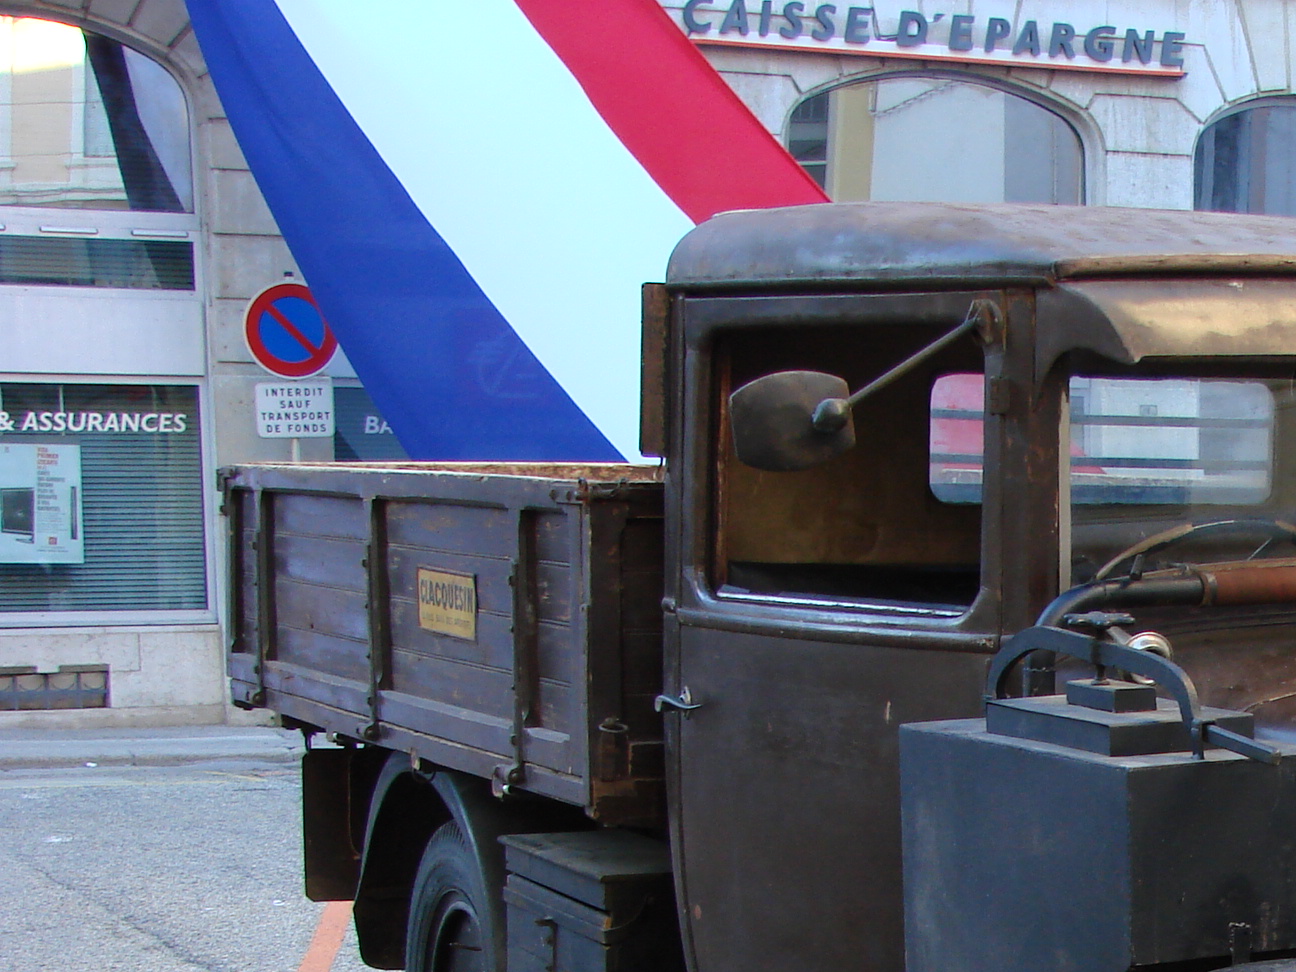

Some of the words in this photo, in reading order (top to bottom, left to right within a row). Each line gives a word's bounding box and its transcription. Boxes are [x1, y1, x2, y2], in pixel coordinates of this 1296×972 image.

[683, 0, 873, 43] CAISSE
[265, 387, 323, 397] INTERDIT
[280, 400, 311, 409] SAUF
[261, 411, 330, 421] TRANSPORT
[22, 412, 187, 433] ASSURANCES
[266, 424, 281, 433] DE
[287, 424, 327, 433] FONDS
